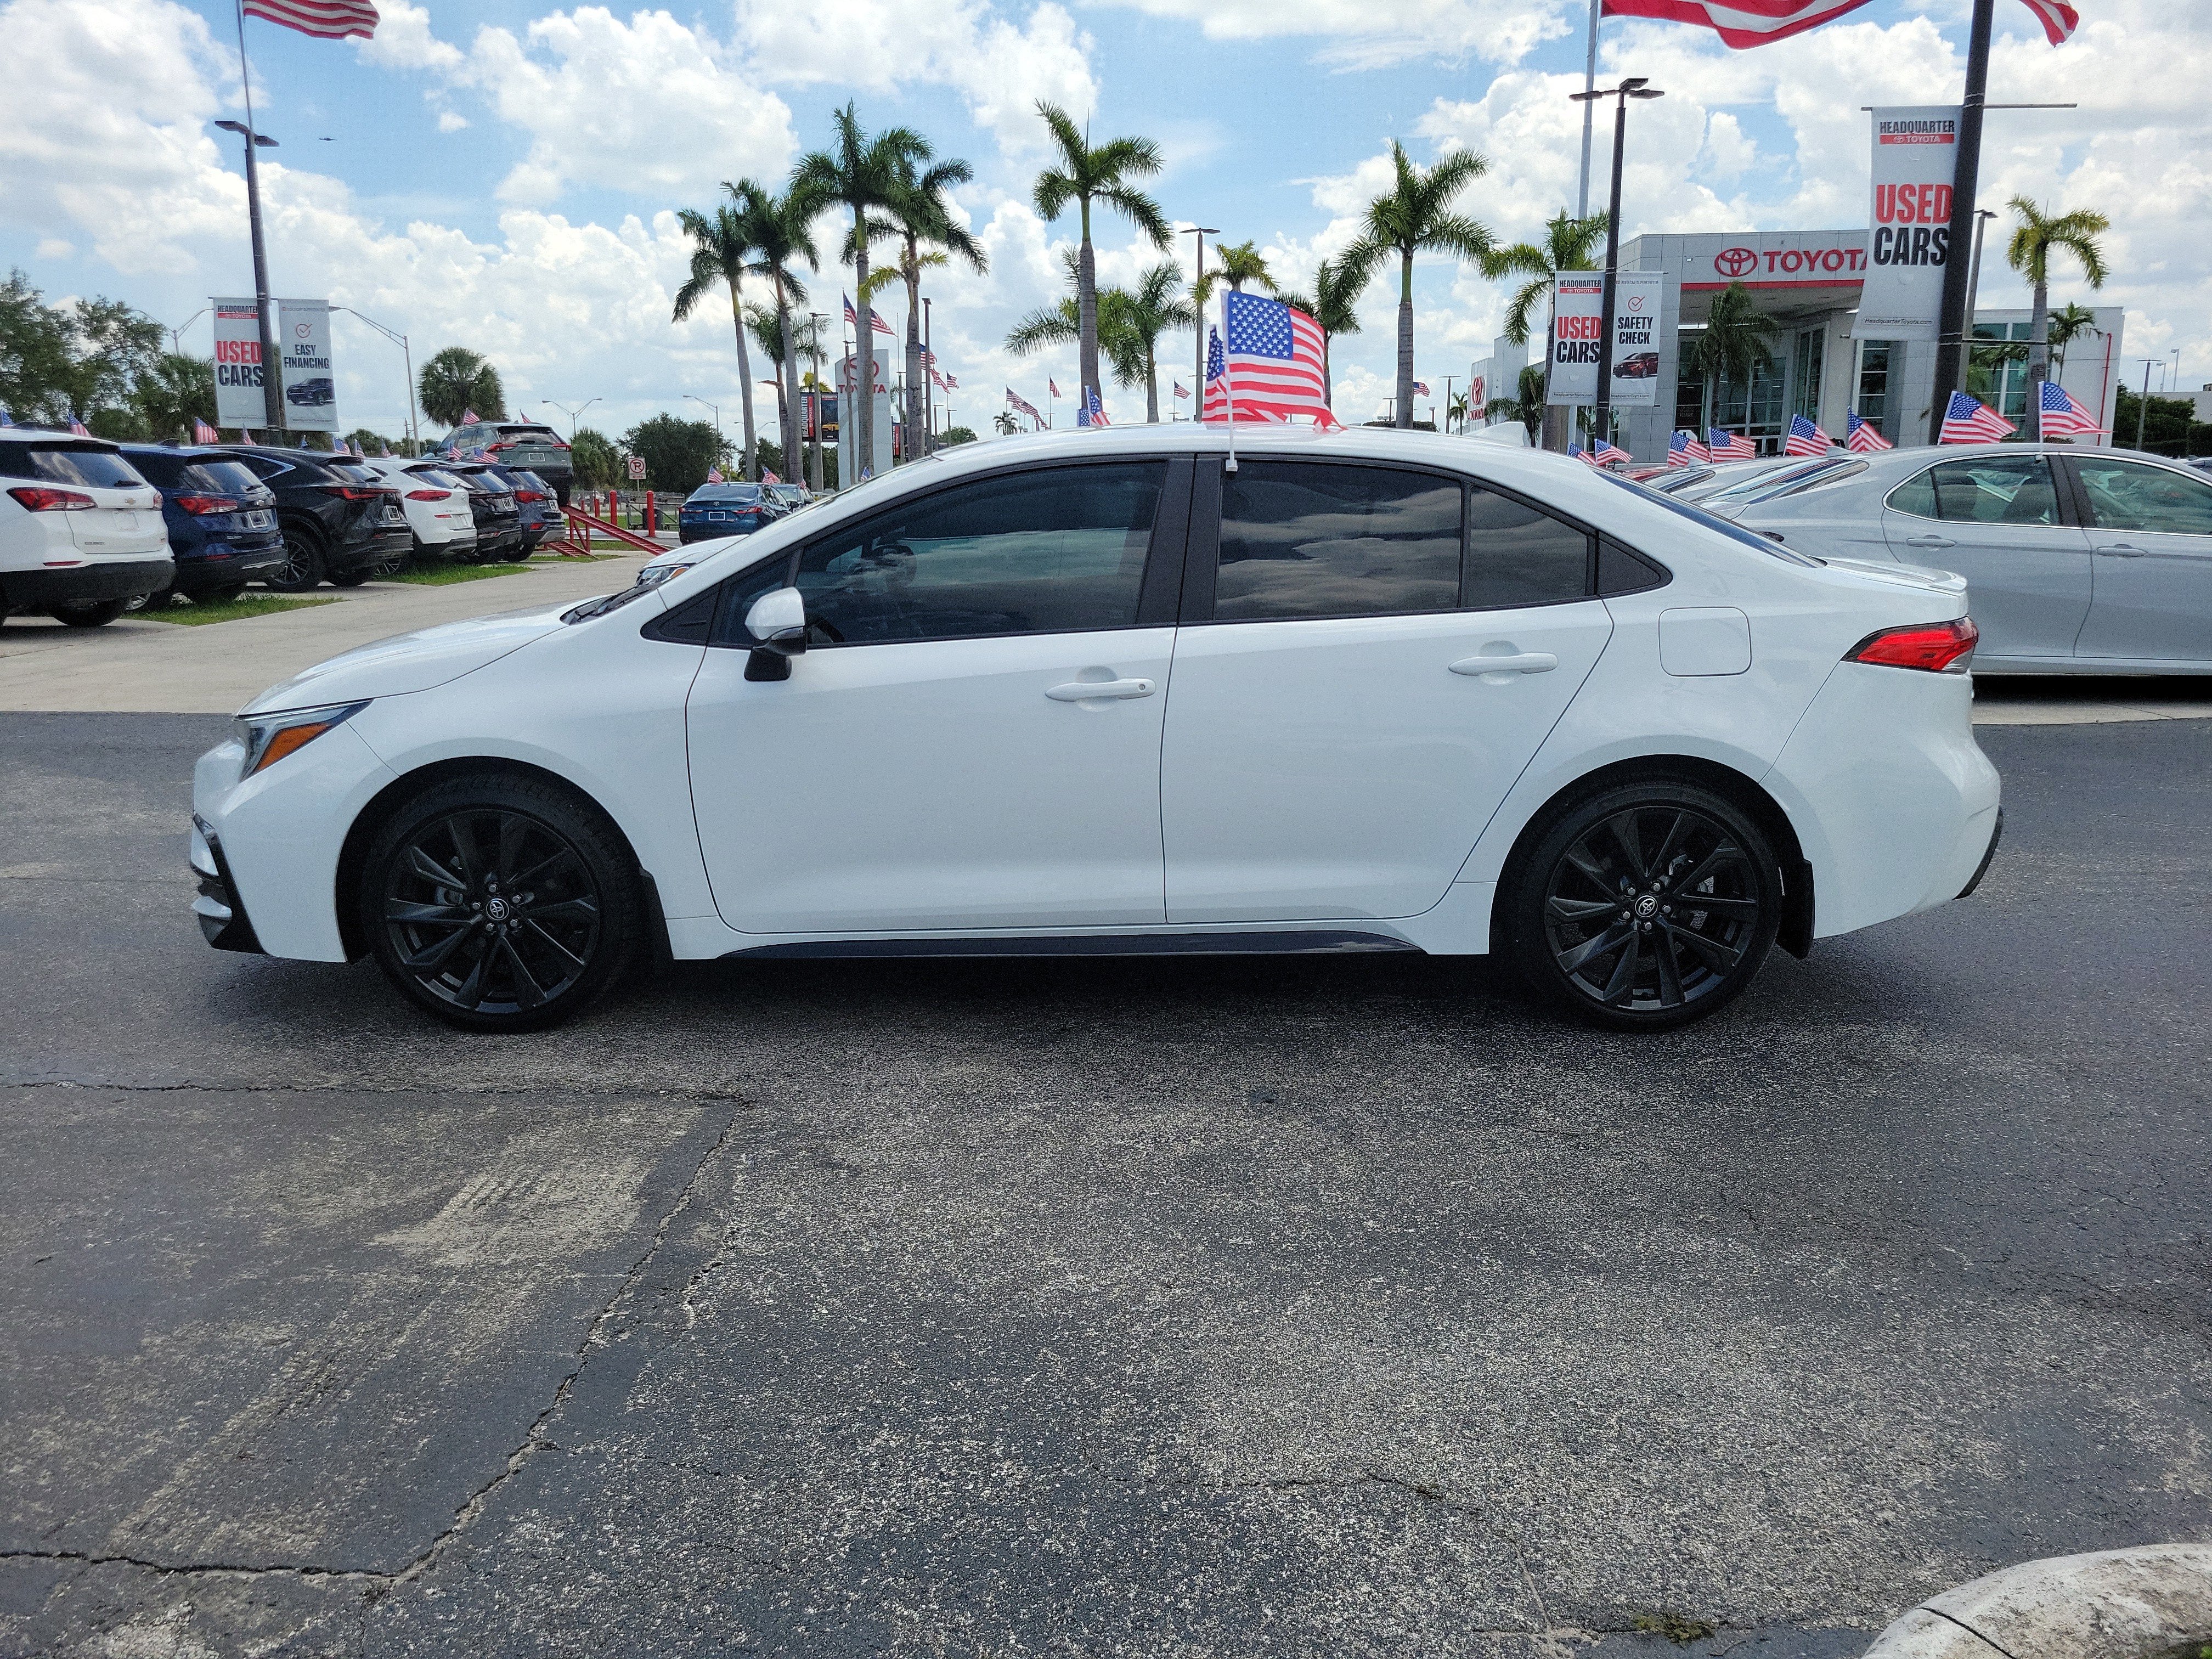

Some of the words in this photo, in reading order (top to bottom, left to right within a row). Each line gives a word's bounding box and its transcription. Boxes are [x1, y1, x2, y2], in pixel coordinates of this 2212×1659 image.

[1880, 120, 1954, 134] HEADQUARTER
[1875, 184, 1954, 224] USED
[1874, 227, 1949, 267] CARS
[1559, 280, 1601, 288] HEADQUARTER
[1558, 316, 1602, 340] USED
[1617, 317, 1654, 330] SAFETY
[1618, 331, 1651, 345] CHECK
[217, 341, 262, 364] USED
[295, 344, 317, 356] EASY
[1556, 341, 1600, 364] CARS
[284, 357, 330, 369] FINANCING
[218, 364, 264, 387] CARS
